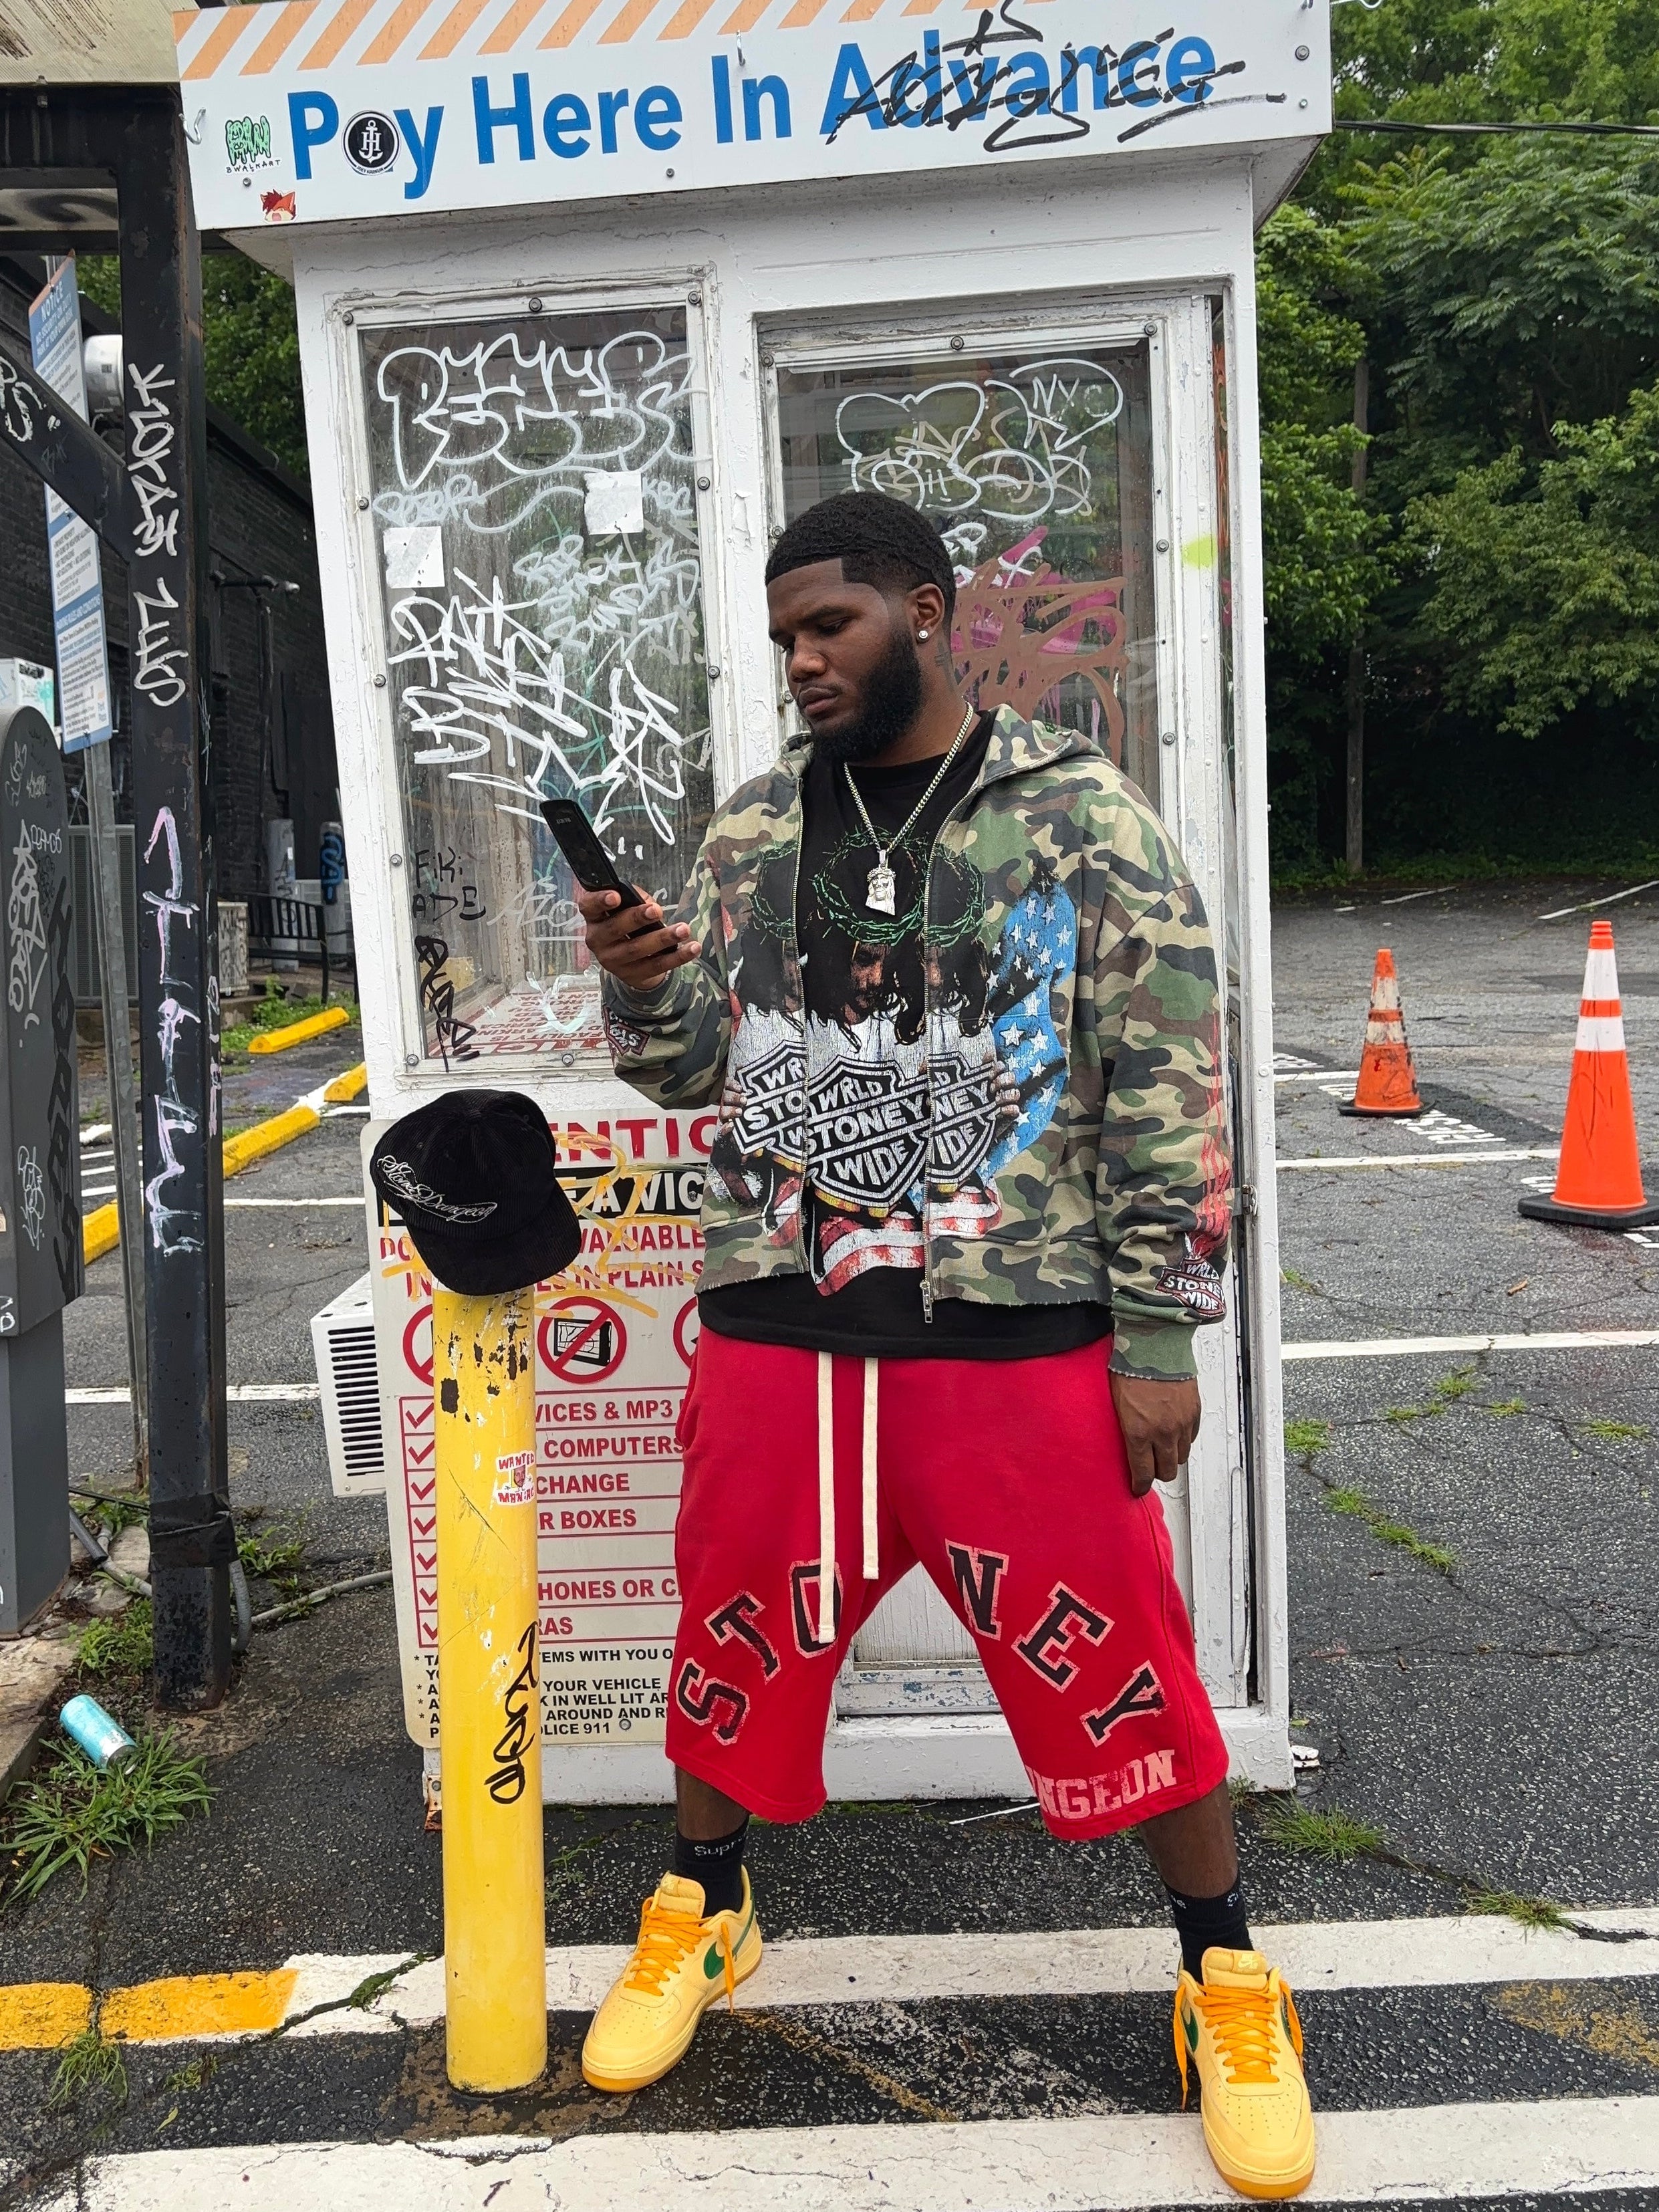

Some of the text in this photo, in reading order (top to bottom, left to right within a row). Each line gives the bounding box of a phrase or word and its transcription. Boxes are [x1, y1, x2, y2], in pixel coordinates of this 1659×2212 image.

[287, 90, 444, 200] Py
[471, 72, 683, 164] Here
[711, 55, 792, 143] In
[819, 29, 1217, 136] Advance
[514, 1031, 603, 1041] FACILITY
[818, 1076, 883, 1112] WRLD
[807, 1094, 924, 1156] STONEY
[834, 1139, 909, 1186] WIDE
[608, 1261, 684, 1288] PLAIN
[1180, 1292, 1219, 1310] WIDE
[604, 1401, 620, 1420] &
[626, 1399, 672, 1419] MP3
[544, 1435, 685, 1459] COMPUTERS
[499, 1453, 535, 1470] WANTED
[537, 1473, 630, 1495] CHANGE
[561, 1508, 637, 1529] BOXES
[538, 1580, 616, 1601] HONES
[622, 1579, 655, 1598] OR
[540, 1650, 575, 1663] EMS
[579, 1649, 621, 1662] WITH
[625, 1648, 658, 1661] YOU
[543, 1678, 661, 1692] YOUR VEHICLE
[553, 1695, 572, 1707] IN
[573, 1693, 616, 1706] WELL
[620, 1693, 644, 1705] LIT
[546, 1708, 613, 1721] AROUND
[618, 1707, 651, 1719] AND
[584, 1722, 610, 1734] 911
[1025, 1749, 1177, 1819] NGEON
